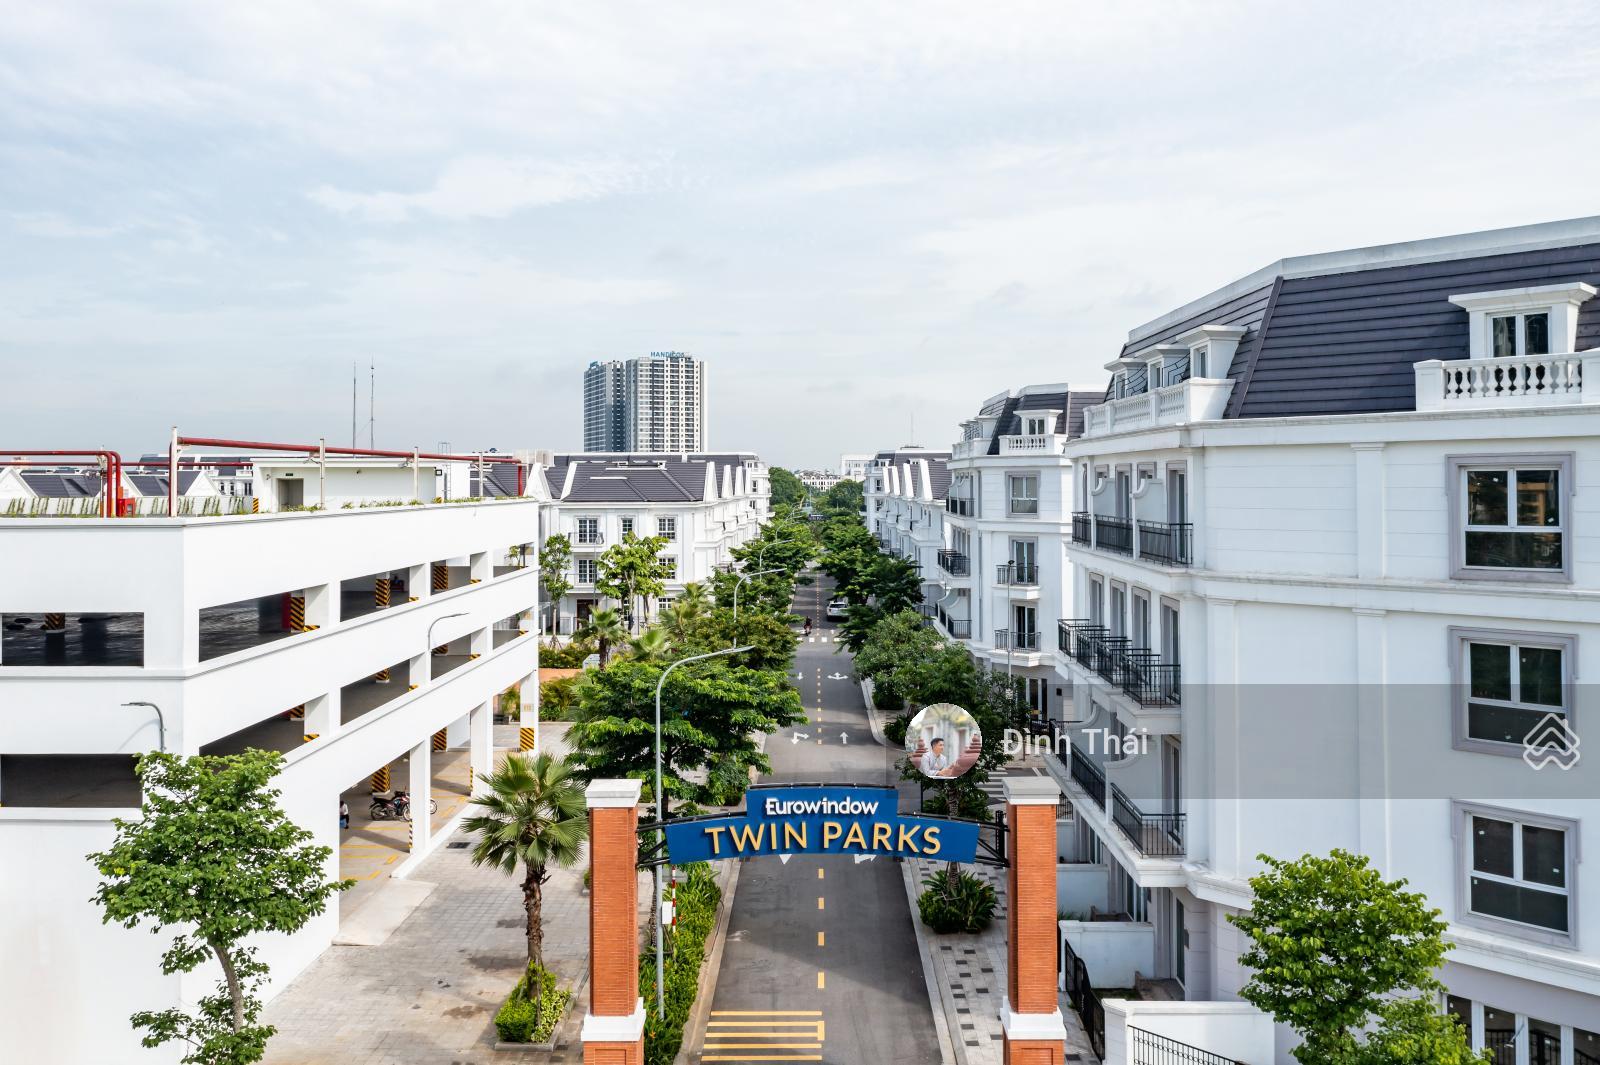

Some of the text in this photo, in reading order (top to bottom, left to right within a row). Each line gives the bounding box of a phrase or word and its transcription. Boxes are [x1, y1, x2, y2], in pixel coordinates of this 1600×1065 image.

[765, 796, 879, 817] Eurowindow
[704, 820, 942, 855] TWIN PARKS
